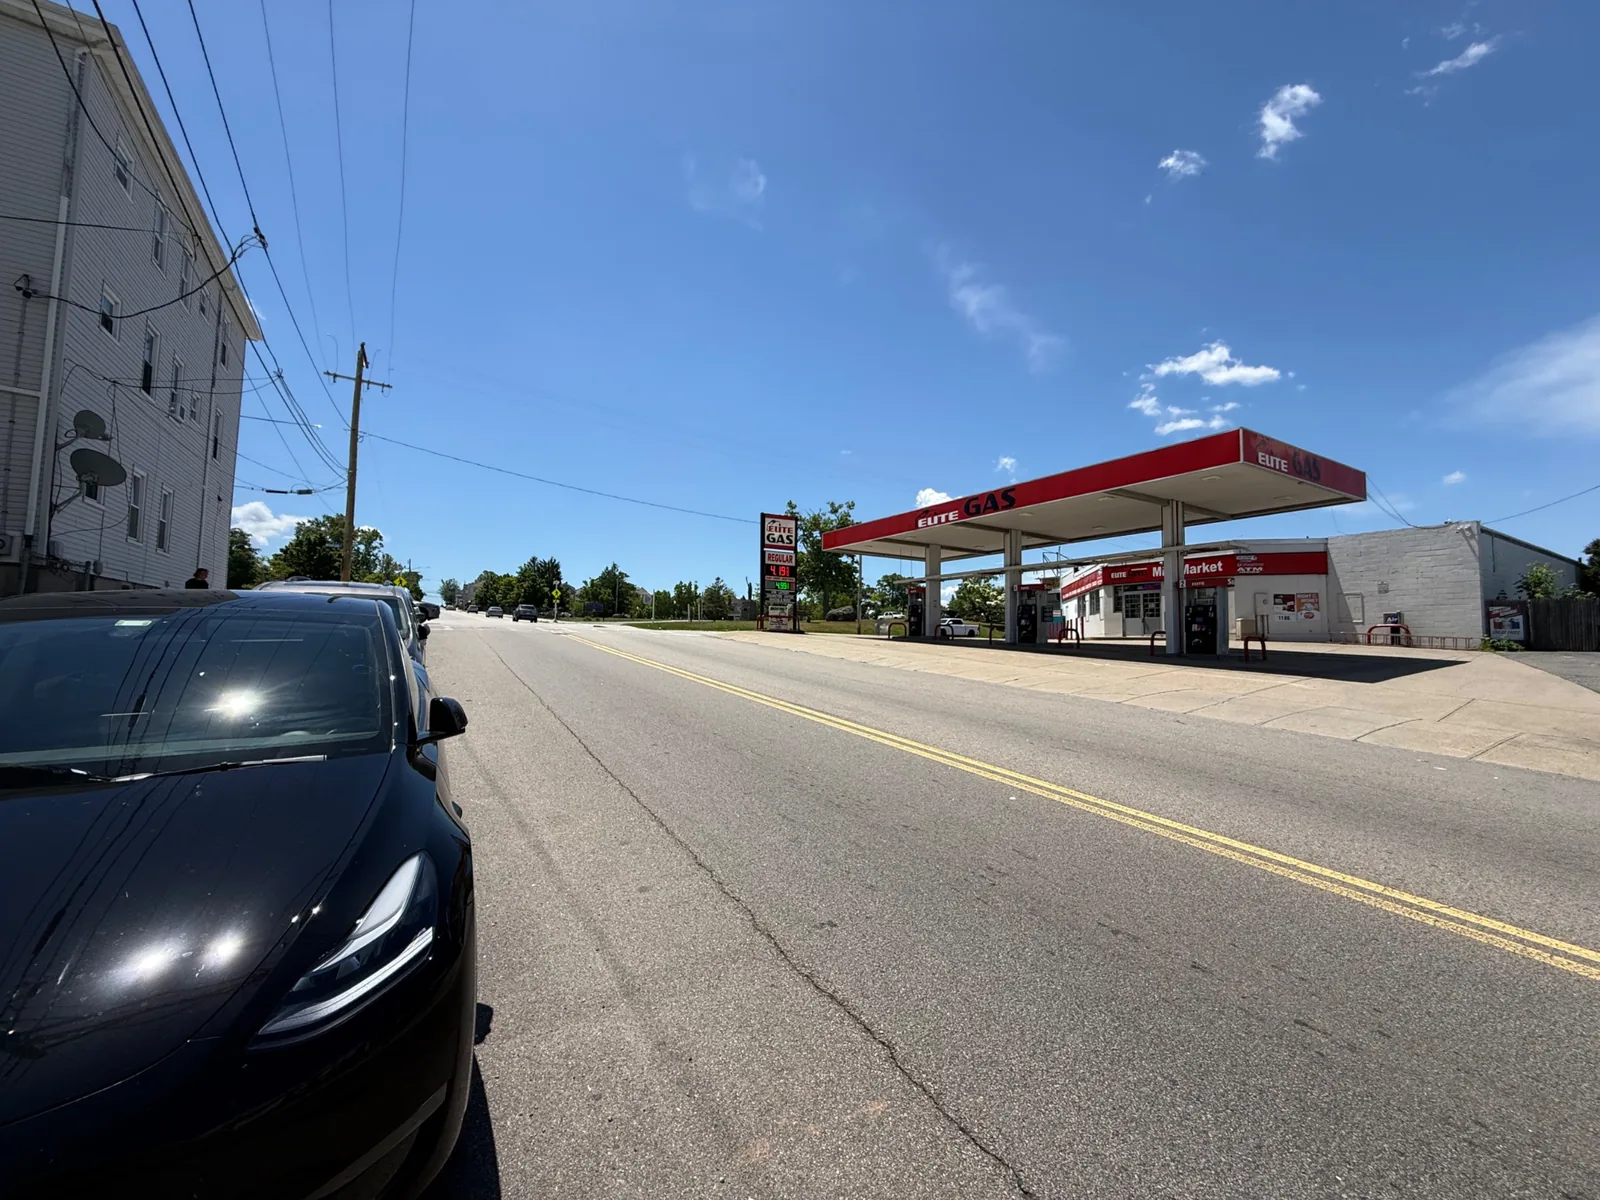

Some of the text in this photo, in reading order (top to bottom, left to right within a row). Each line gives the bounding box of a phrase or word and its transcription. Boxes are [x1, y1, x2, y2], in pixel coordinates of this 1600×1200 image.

[1258, 449, 1320, 482] ELITE GAS
[917, 487, 1016, 528] ELITE GAS
[767, 525, 793, 534] ELITE
[766, 533, 794, 545] GAS
[767, 553, 793, 564] REGULAR
[1110, 571, 1127, 579] ELITE
[1152, 566, 1164, 578] Mi
[1184, 560, 1223, 575] Market
